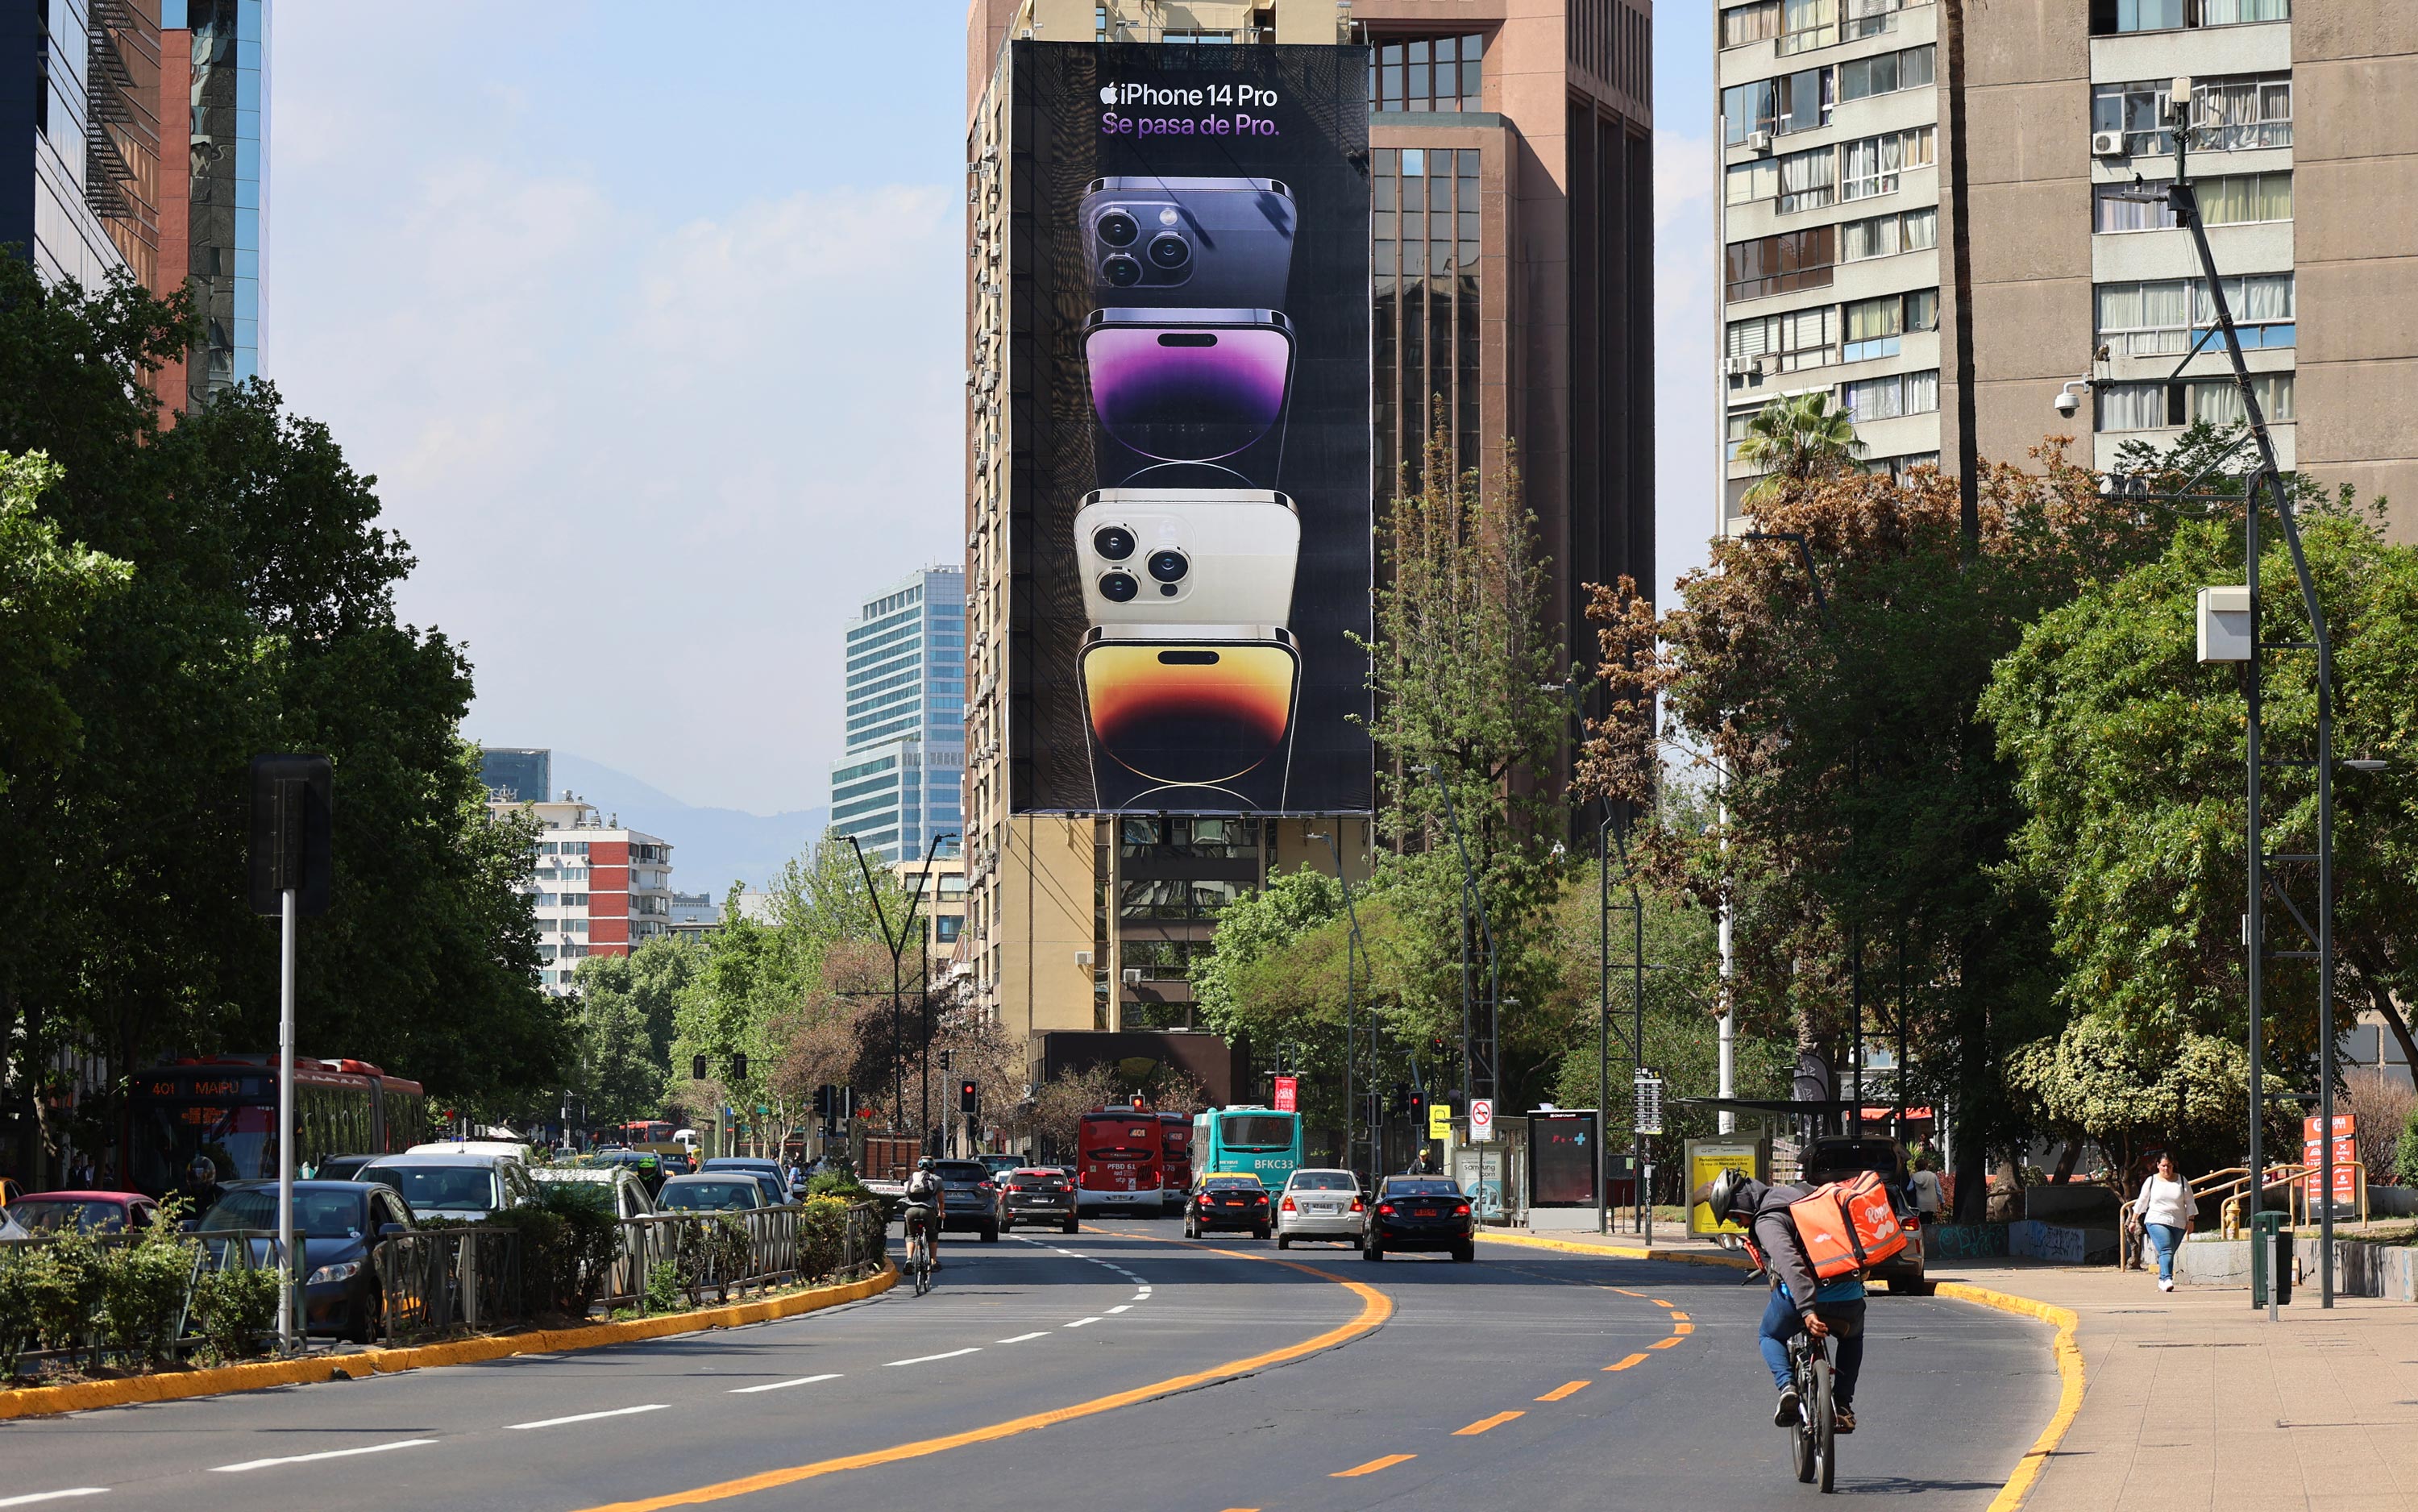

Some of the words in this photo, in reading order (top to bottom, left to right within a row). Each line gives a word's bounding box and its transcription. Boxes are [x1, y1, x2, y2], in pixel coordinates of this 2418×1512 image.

[1120, 83, 1203, 106] iPhone
[1207, 84, 1233, 106] 14
[1238, 85, 1278, 106] Pro
[1102, 111, 1133, 135] Se
[1138, 118, 1194, 139] pasa
[1199, 114, 1230, 135] de
[1236, 114, 1280, 135] Pro.
[152, 1082, 175, 1095] 401
[195, 1082, 239, 1095] MAIPU
[1254, 1159, 1294, 1169] BFKC33
